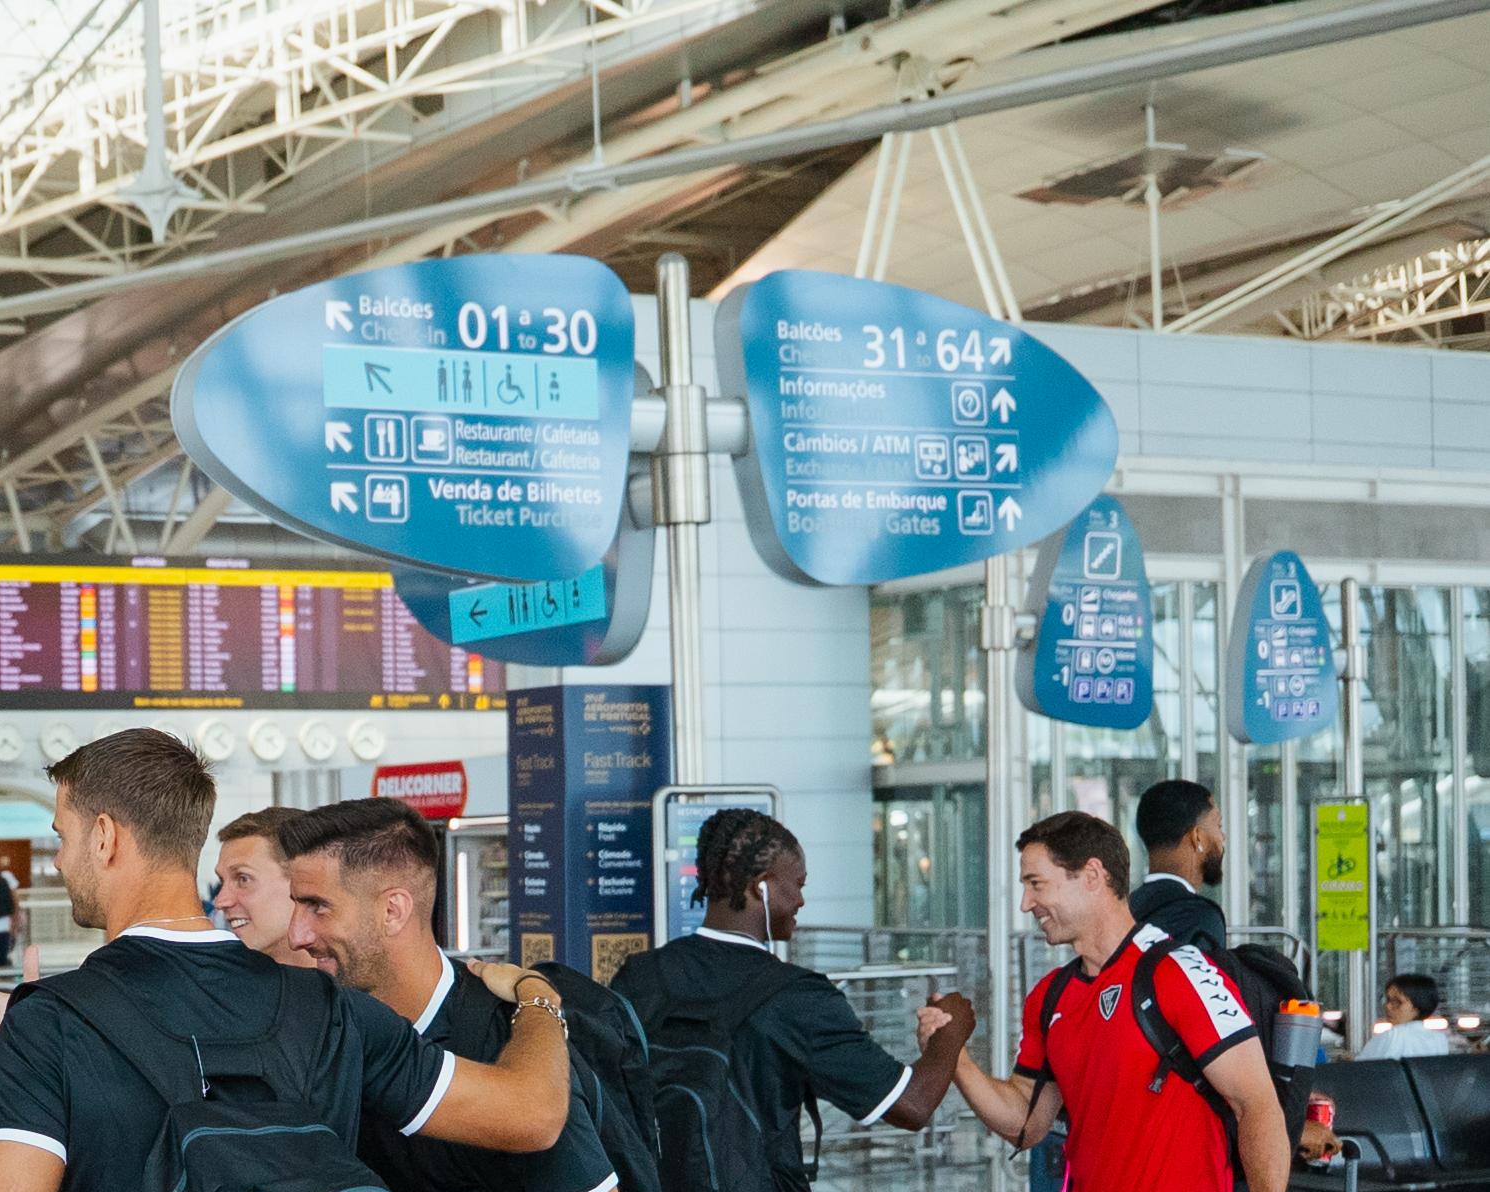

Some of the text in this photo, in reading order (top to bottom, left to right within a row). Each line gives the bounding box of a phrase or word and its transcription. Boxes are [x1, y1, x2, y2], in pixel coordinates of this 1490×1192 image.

[359, 295, 597, 355] Balcões 01 a 30
[518, 332, 536, 349] to
[777, 320, 842, 342] Balcões
[862, 325, 906, 369] 31
[916, 331, 927, 346] a
[936, 328, 985, 372] 64
[779, 376, 886, 402] Informações
[456, 420, 533, 442] Restaurante
[542, 424, 599, 445] Cafetaria
[784, 432, 857, 452] Câmbios
[873, 434, 910, 454] ATM
[456, 446, 530, 467] Restaurant
[428, 478, 602, 504] Venda de Bilhetes
[786, 489, 947, 514] Portas de Embarque
[455, 504, 515, 527] Ticket
[885, 512, 940, 536] Gates
[1062, 603, 1075, 626] 0
[584, 752, 651, 769] Fast Track
[378, 773, 462, 798] DELICORNER
